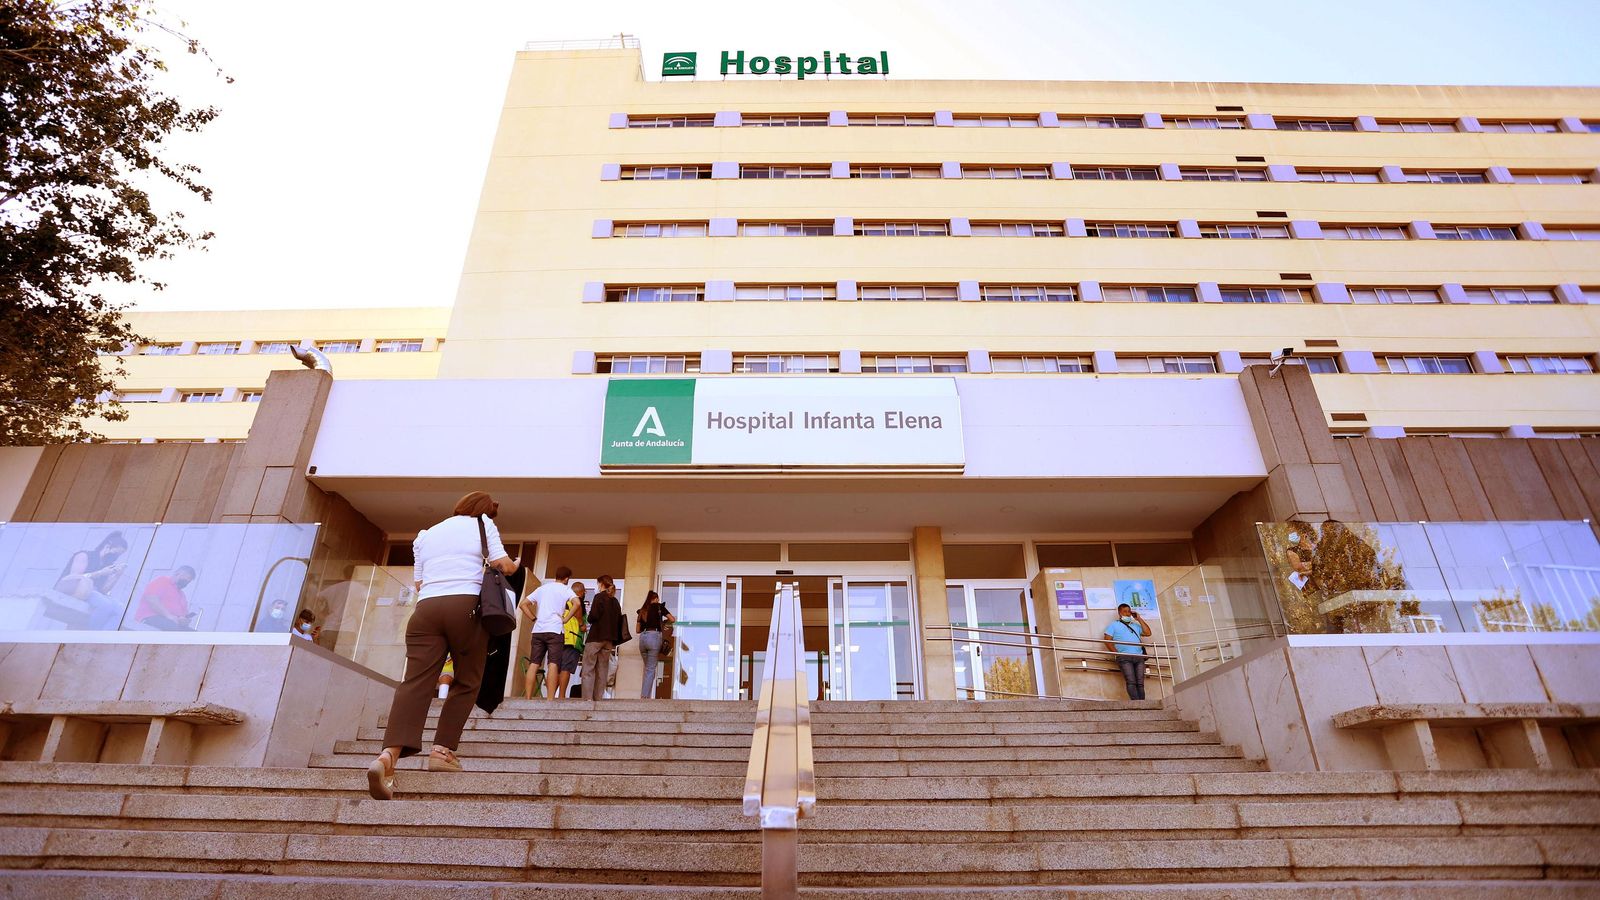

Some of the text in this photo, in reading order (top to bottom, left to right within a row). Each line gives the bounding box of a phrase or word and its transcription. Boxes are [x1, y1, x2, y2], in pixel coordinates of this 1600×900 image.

[720, 50, 890, 80] Hospital
[707, 410, 943, 434] Hospital Infanta Elena
[611, 438, 685, 448] Junta de Andalucía
